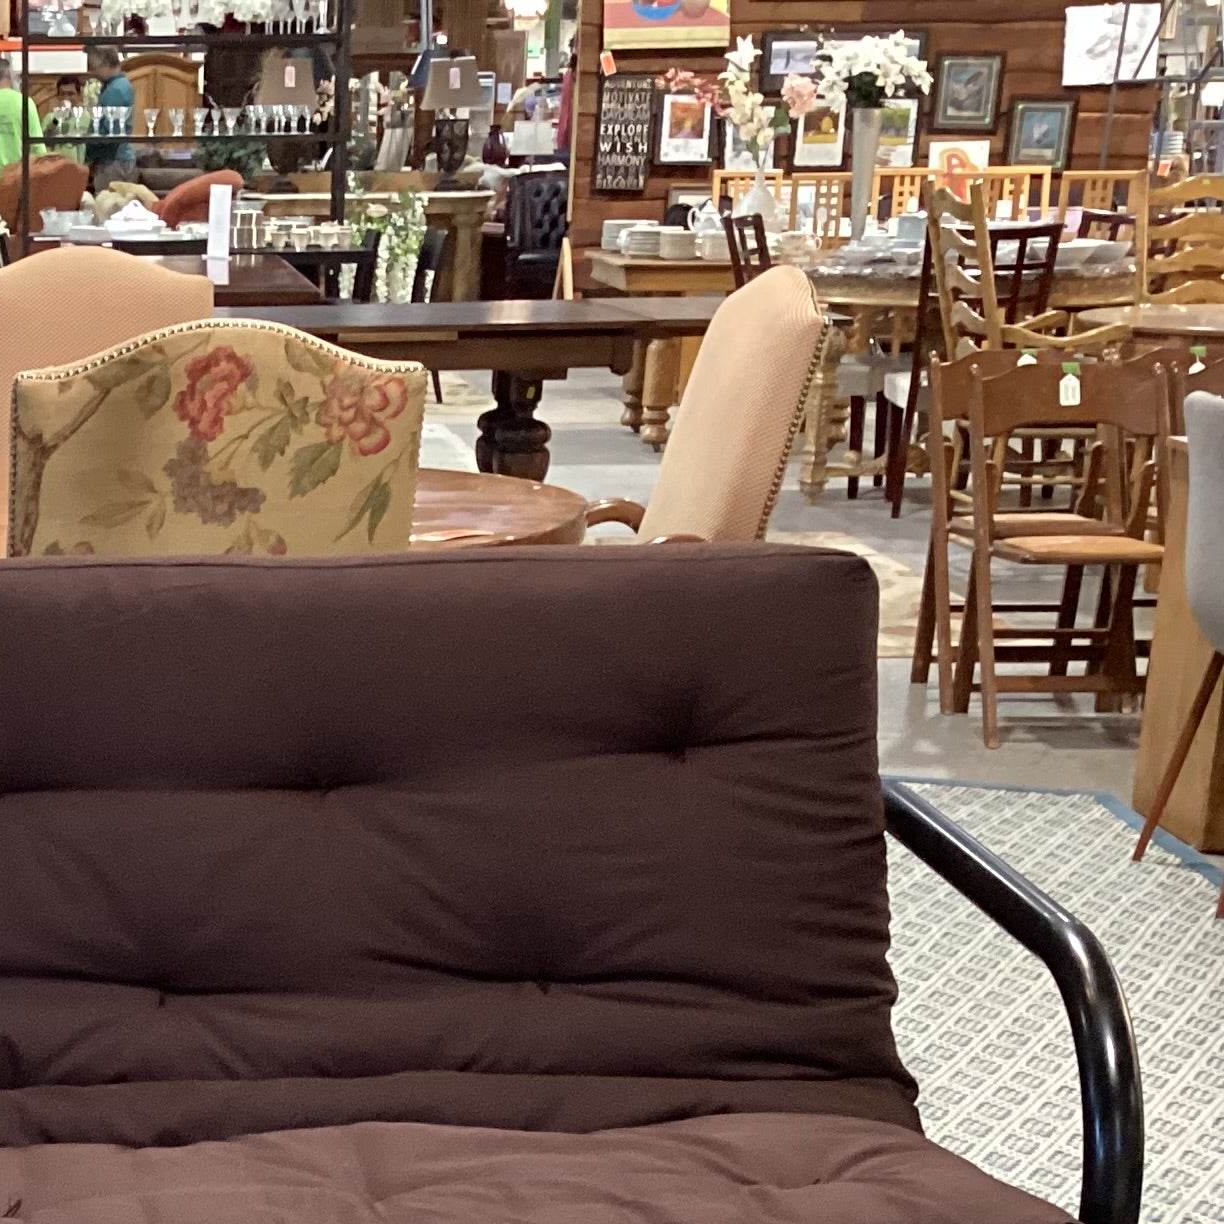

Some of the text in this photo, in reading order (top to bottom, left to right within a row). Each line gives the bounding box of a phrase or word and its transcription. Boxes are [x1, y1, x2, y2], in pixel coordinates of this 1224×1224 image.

[603, 91, 652, 103] MOTIVATE
[600, 123, 649, 135] EXPLORE
[600, 141, 648, 153] WISH
[597, 152, 647, 166] HARMONY
